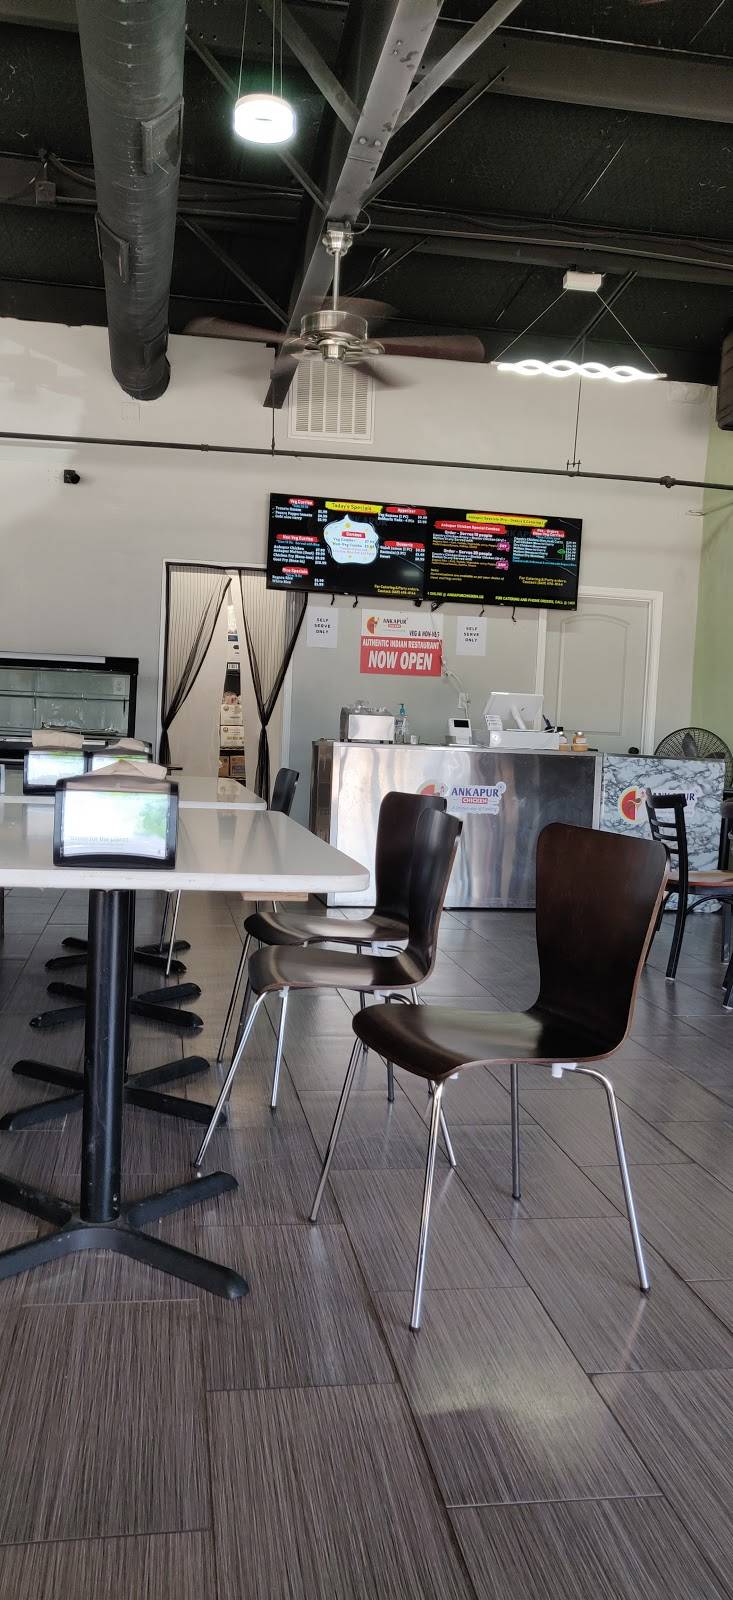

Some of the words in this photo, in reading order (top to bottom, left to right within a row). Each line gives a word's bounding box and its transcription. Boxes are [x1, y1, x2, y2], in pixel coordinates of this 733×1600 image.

[362, 638, 390, 648] AUTHENTIC
[390, 640, 408, 648] INDIAN
[408, 641, 440, 650] RESTAURANT
[368, 650, 398, 670] NOW
[400, 652, 432, 670] OPEN
[452, 787, 500, 798] ANKAPUR
